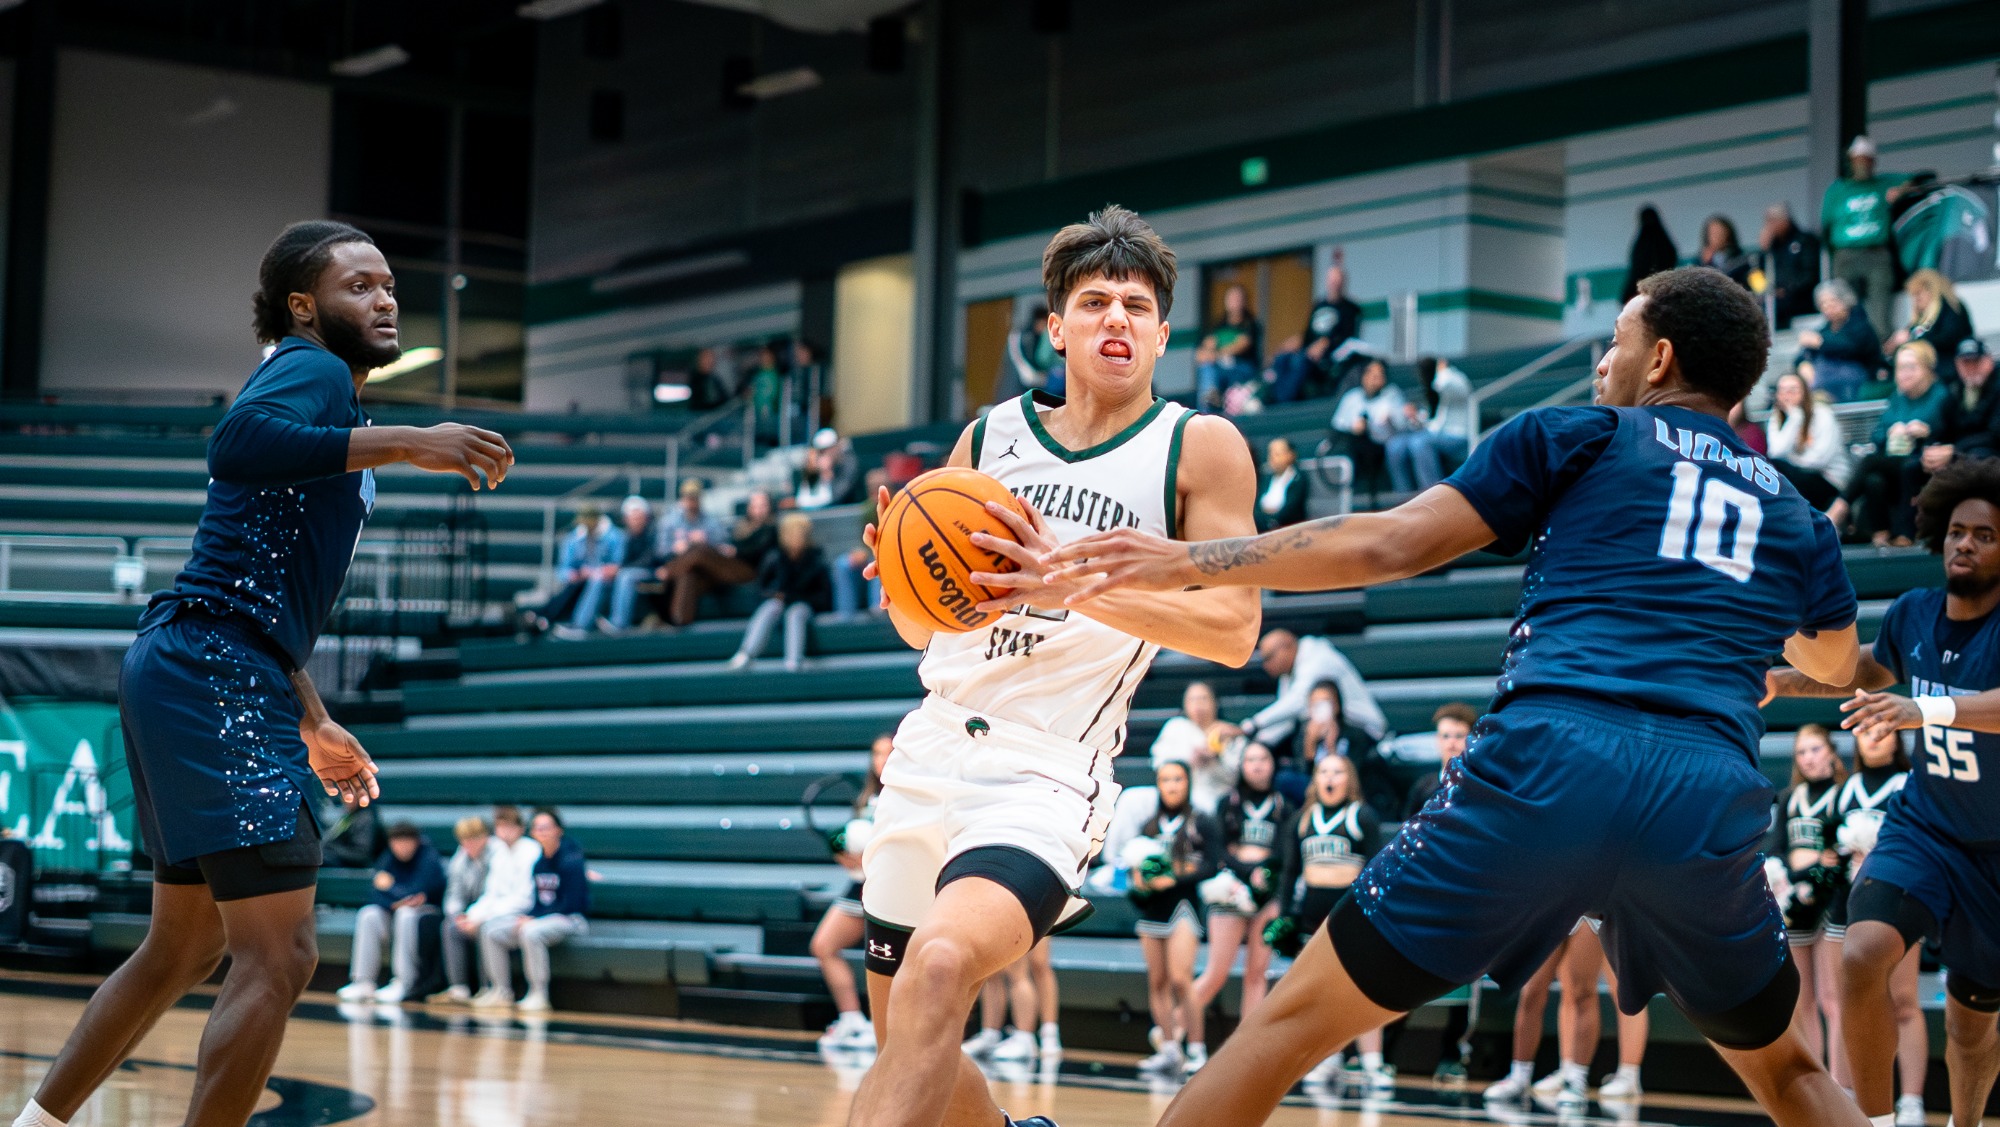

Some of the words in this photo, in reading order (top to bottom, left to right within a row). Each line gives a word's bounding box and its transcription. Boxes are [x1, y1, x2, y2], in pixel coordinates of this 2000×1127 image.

[1654, 417, 1780, 495] LIONS
[1657, 461, 1764, 583] 10
[918, 539, 988, 627] Wilson
[1922, 724, 1981, 782] 55
